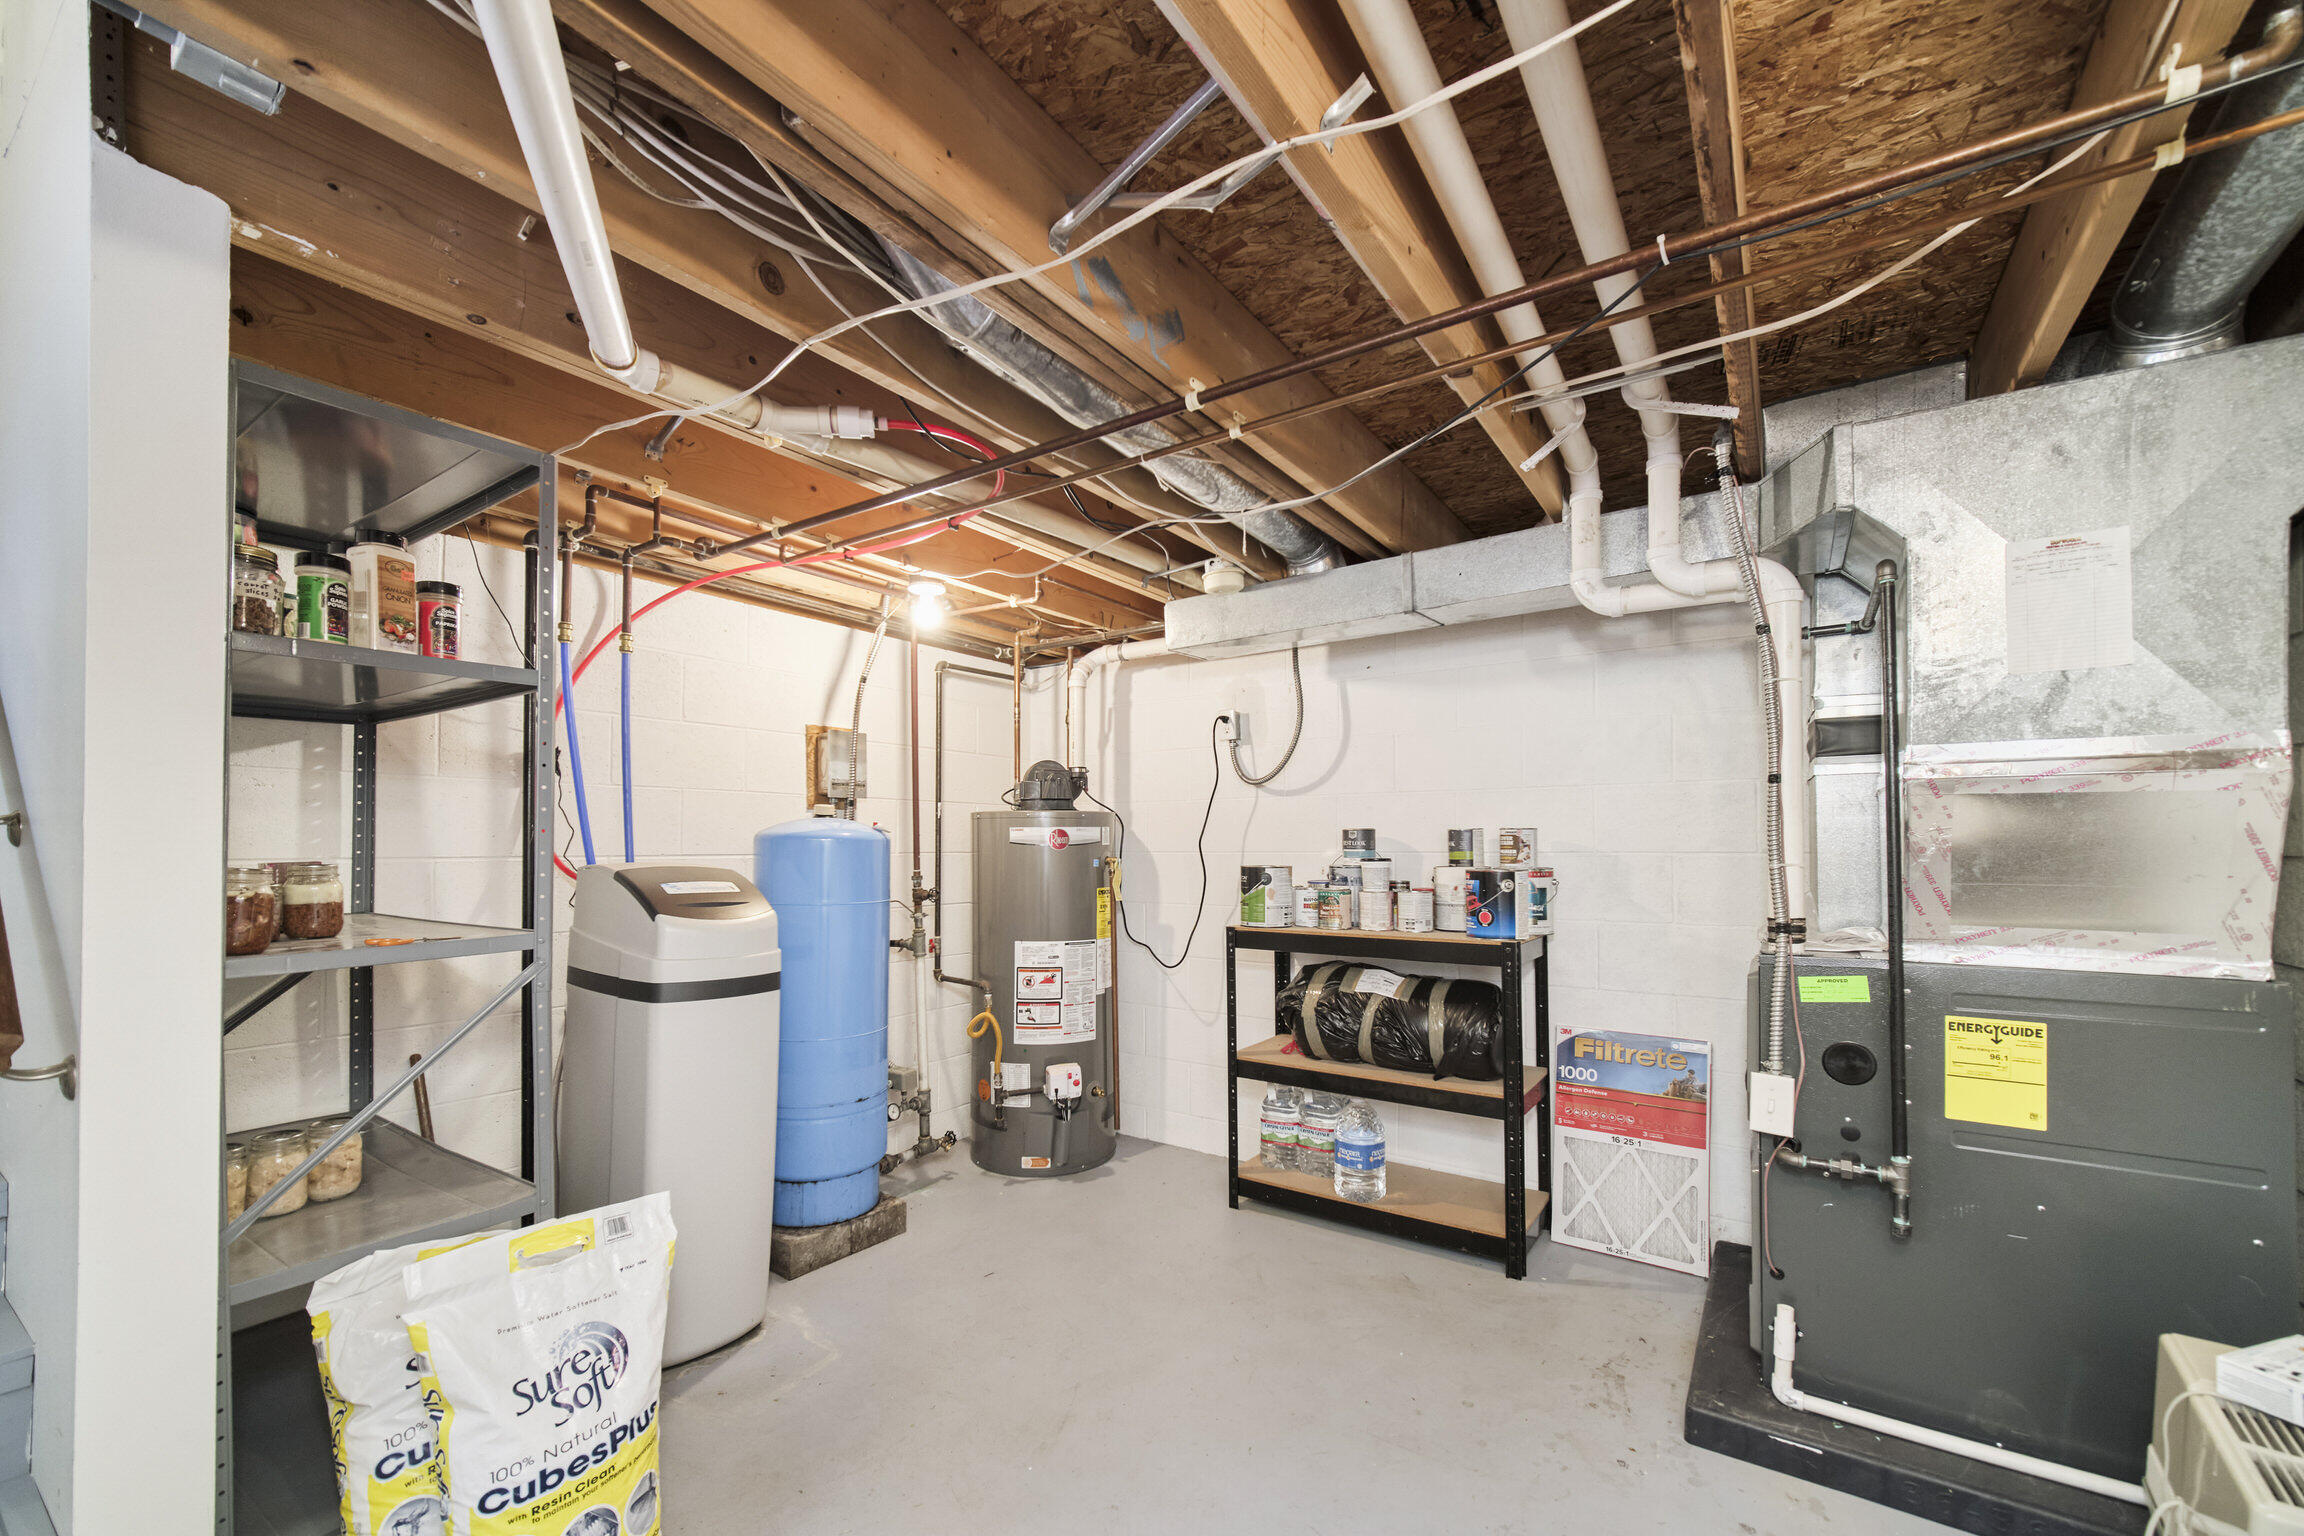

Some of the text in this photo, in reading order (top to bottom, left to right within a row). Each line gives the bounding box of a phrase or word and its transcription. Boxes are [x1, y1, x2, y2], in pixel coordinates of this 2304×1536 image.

[385, 592, 411, 604] ONION
[1954, 928, 1998, 945] POLYKEN
[1560, 1028, 1572, 1036] 3M
[1574, 1036, 1688, 1071] Filtrete
[1989, 1053, 2009, 1062] 96.1
[1557, 1064, 1598, 1083] 1000
[1558, 1084, 1608, 1097] Allergen Defense
[537, 1309, 563, 1322] Water
[566, 1296, 601, 1313] Softener
[603, 1288, 619, 1300] Salt
[512, 1349, 592, 1417] Sure
[550, 1356, 616, 1428] Soft
[383, 1420, 429, 1451] 100%
[490, 1411, 617, 1485] 100% Natural
[374, 1441, 432, 1480] Cu
[477, 1400, 658, 1515] CubesPlus
[507, 1464, 616, 1526] with Resin Clean
[532, 1516, 541, 1524] to
[543, 1496, 579, 1519] maintain
[582, 1485, 599, 1500] your
